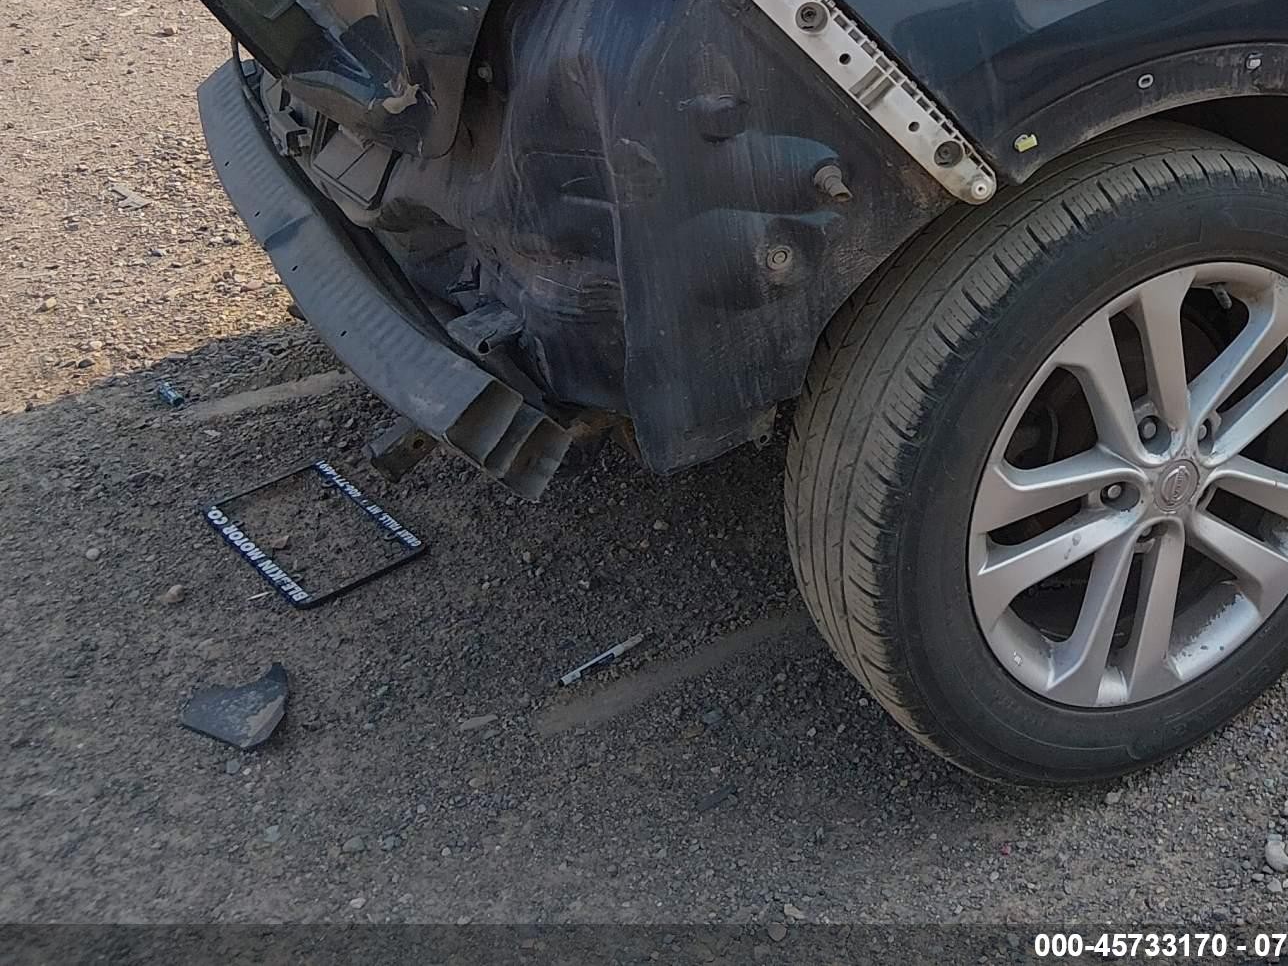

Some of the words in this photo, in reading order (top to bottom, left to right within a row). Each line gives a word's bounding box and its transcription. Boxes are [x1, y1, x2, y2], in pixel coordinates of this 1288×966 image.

[207, 505, 229, 525] CO.
[222, 524, 266, 561] MOTOR
[397, 525, 421, 546] GREAT
